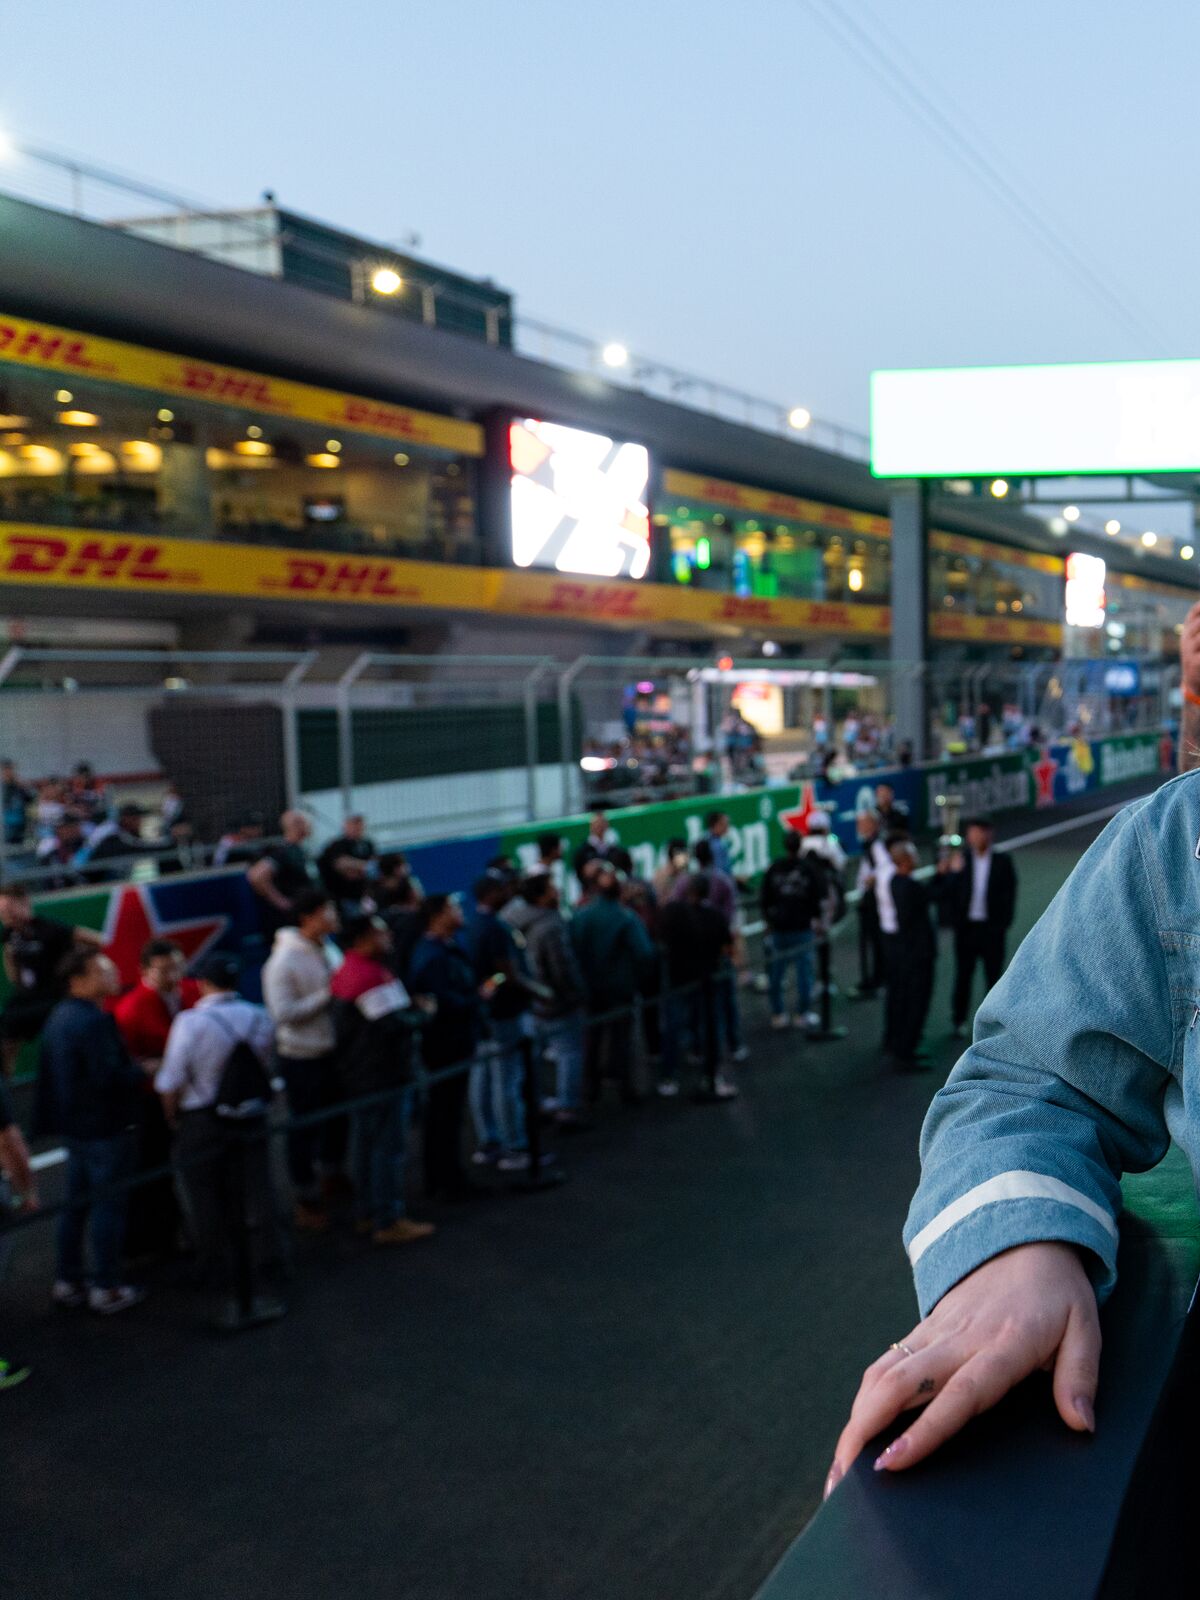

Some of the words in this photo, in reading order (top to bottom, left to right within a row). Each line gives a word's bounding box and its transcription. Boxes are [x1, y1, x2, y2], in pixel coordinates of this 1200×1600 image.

[180, 362, 277, 406] DHL
[7, 535, 171, 582] DHL
[285, 557, 399, 596] DHL
